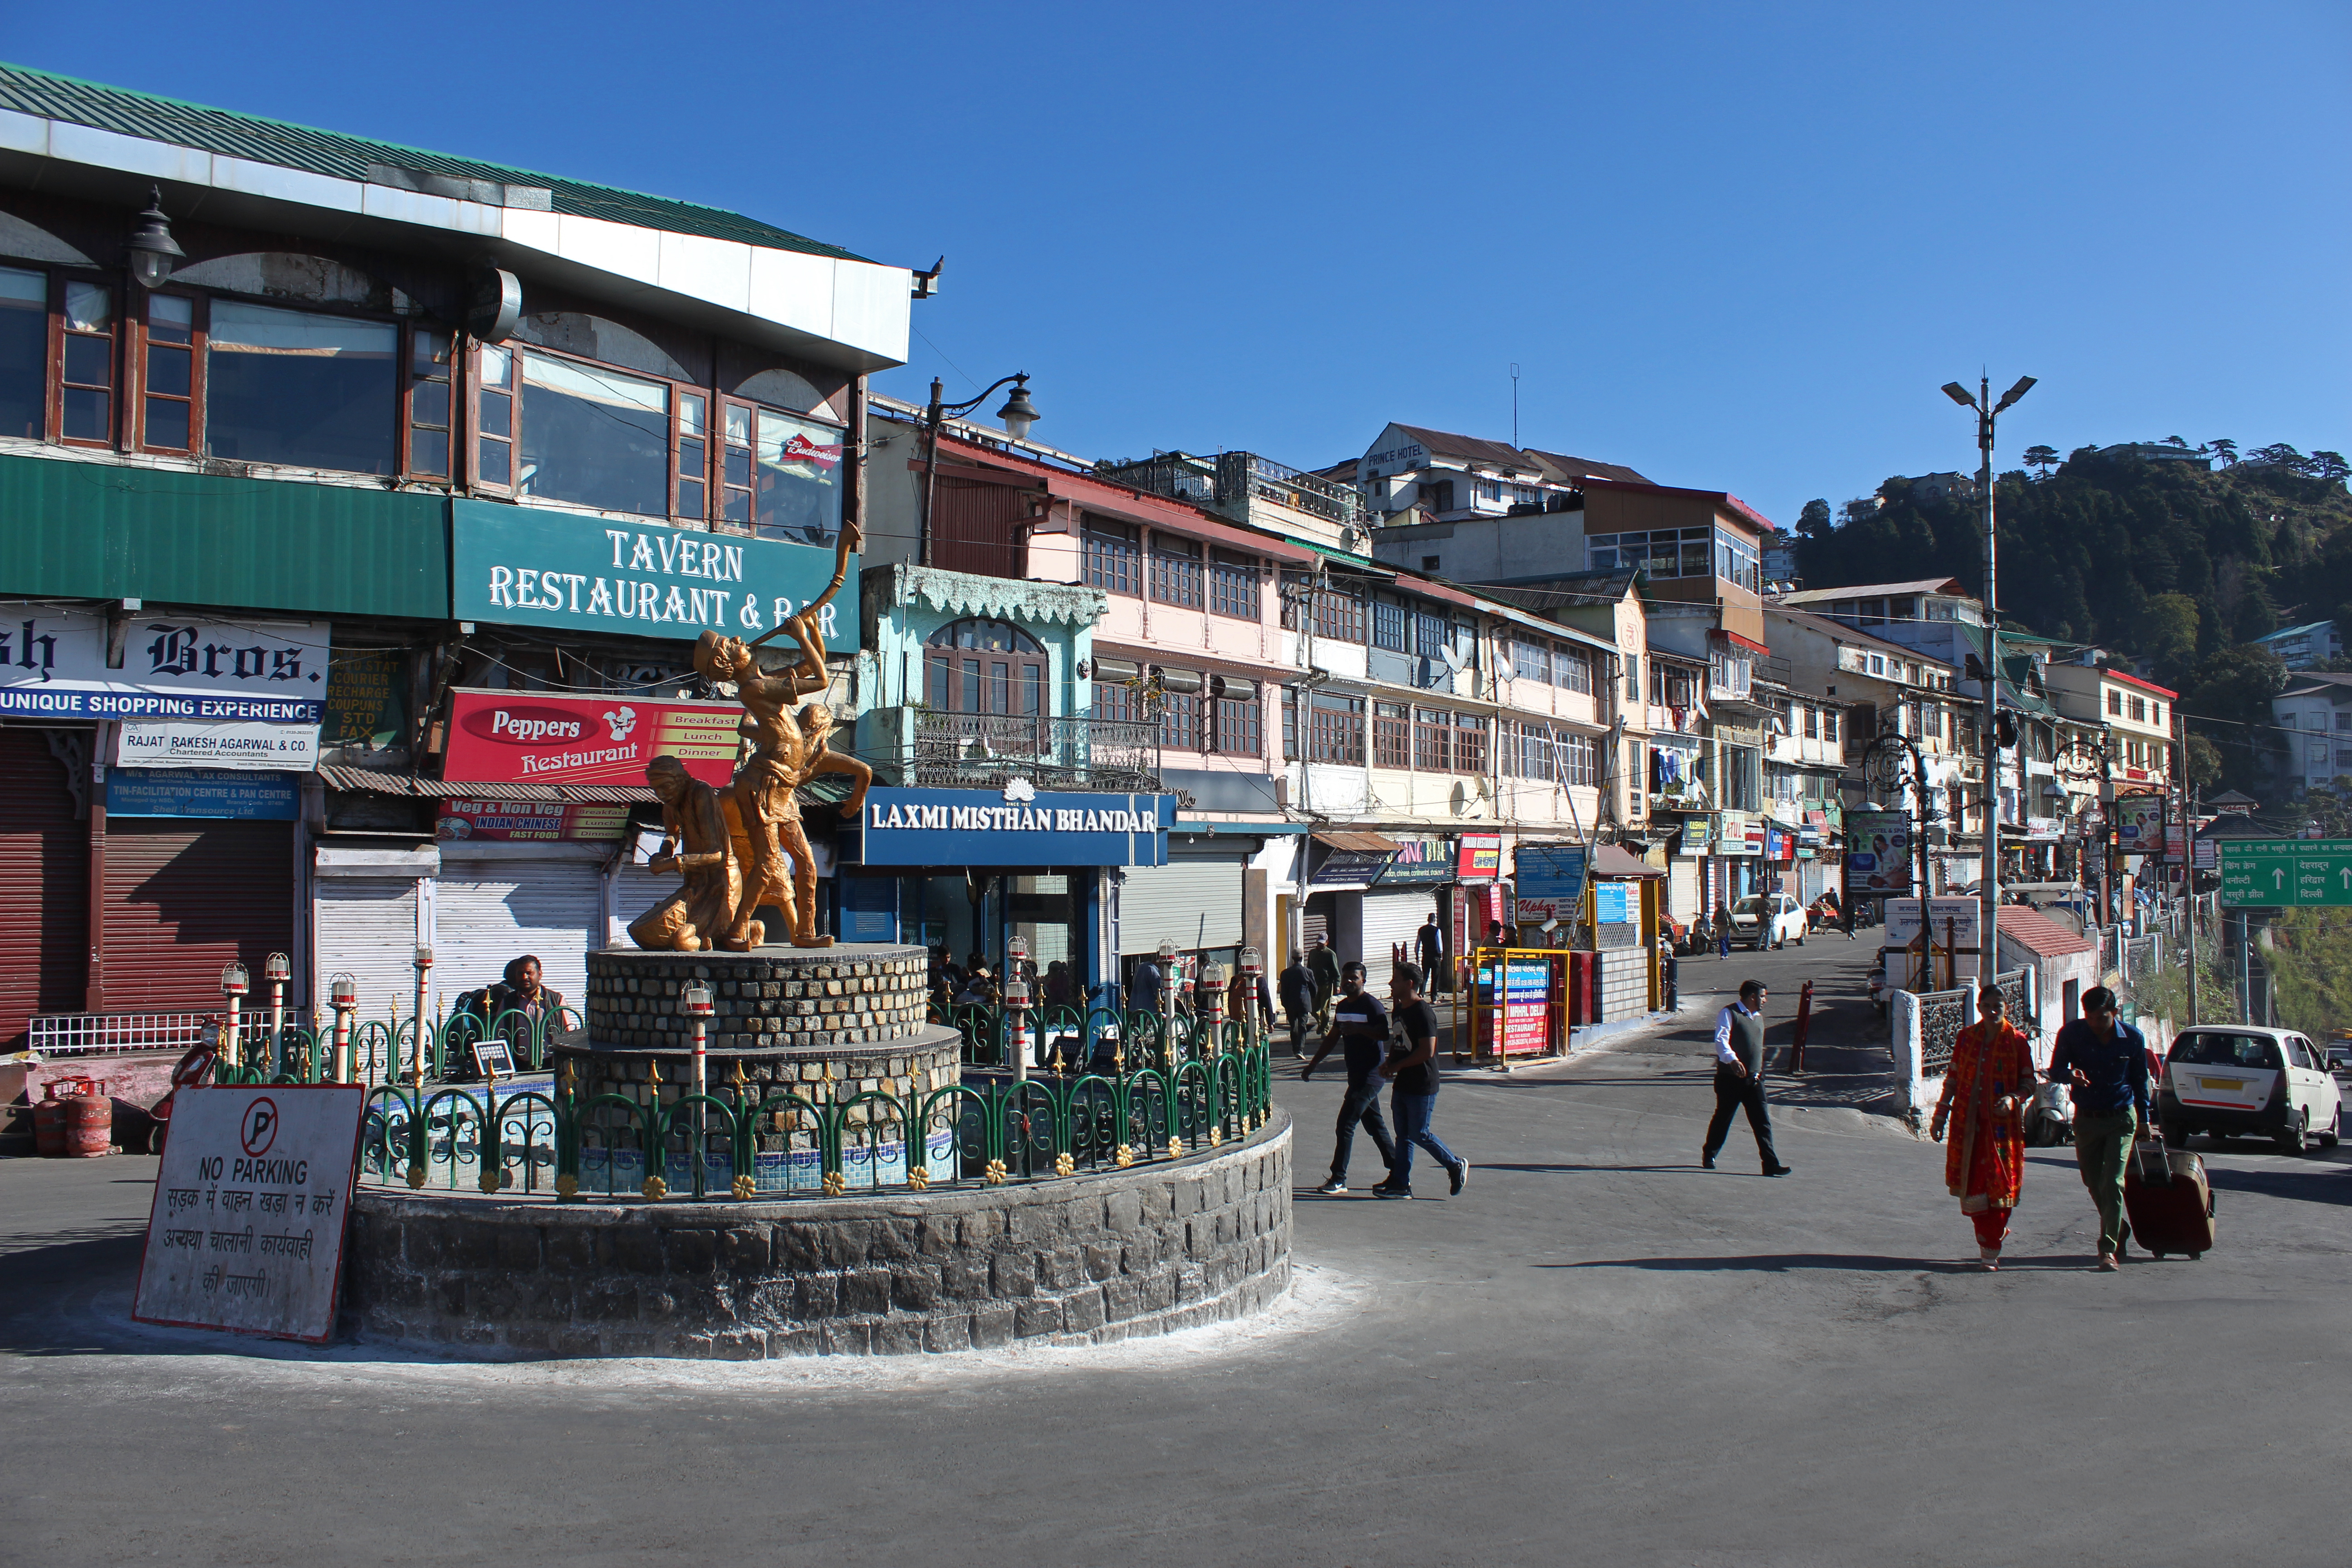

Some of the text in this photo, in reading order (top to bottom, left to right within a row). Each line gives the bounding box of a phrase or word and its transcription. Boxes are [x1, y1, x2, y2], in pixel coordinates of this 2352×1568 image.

[787, 440, 841, 462] Budweiser
[1368, 444, 1422, 466] PRINCE HOTEL
[606, 529, 744, 583] TAVERN
[489, 566, 840, 640] RESTAURANT & BR
[145, 623, 321, 683] Bros.
[366, 661, 399, 672] STAT
[334, 672, 389, 686] COURIER
[327, 686, 390, 698] RECHARGE
[0, 692, 317, 720] UNIQUE SHOPPING EXPERIENCE
[343, 712, 375, 724] STD
[492, 710, 580, 740] Peppers
[675, 716, 737, 725] Breakfast
[340, 725, 374, 738] FAX
[683, 732, 723, 741] Lunch
[127, 735, 309, 751] RAJAT RAKESH AGARWAL & CO.
[520, 742, 638, 774] Restaurant
[678, 749, 723, 757] Dinner
[149, 771, 195, 779] AGARWAL
[217, 773, 281, 781] CONSULTANTS
[113, 785, 292, 799] TIN-FACILITATION CENTRE & PAN CENTRE
[181, 806, 235, 814] Transource
[451, 800, 564, 816] Veg & Non Veg
[474, 816, 561, 830] INDIAN CHINESE
[870, 804, 1156, 833] LAXMI MISTHAN BHANDAR
[1725, 822, 1742, 838] ATUL
[1477, 837, 1500, 849] RESTAURANT
[2299, 860, 2329, 871] देहरादून
[2300, 875, 2325, 884] हरिद्वार
[2225, 889, 2264, 900] मसूरी झील
[2300, 888, 2323, 898] दिल्ली
[1518, 899, 1557, 915] Uphar
[1510, 1005, 1529, 1018] MAHAL
[199, 1156, 308, 1185] NO PARKING
[168, 1182, 336, 1217] सड़क में वाहन खड़ा न करें
[163, 1225, 314, 1261] अन्यथा चालानी कार्यवाही
[202, 1264, 220, 1293] की
